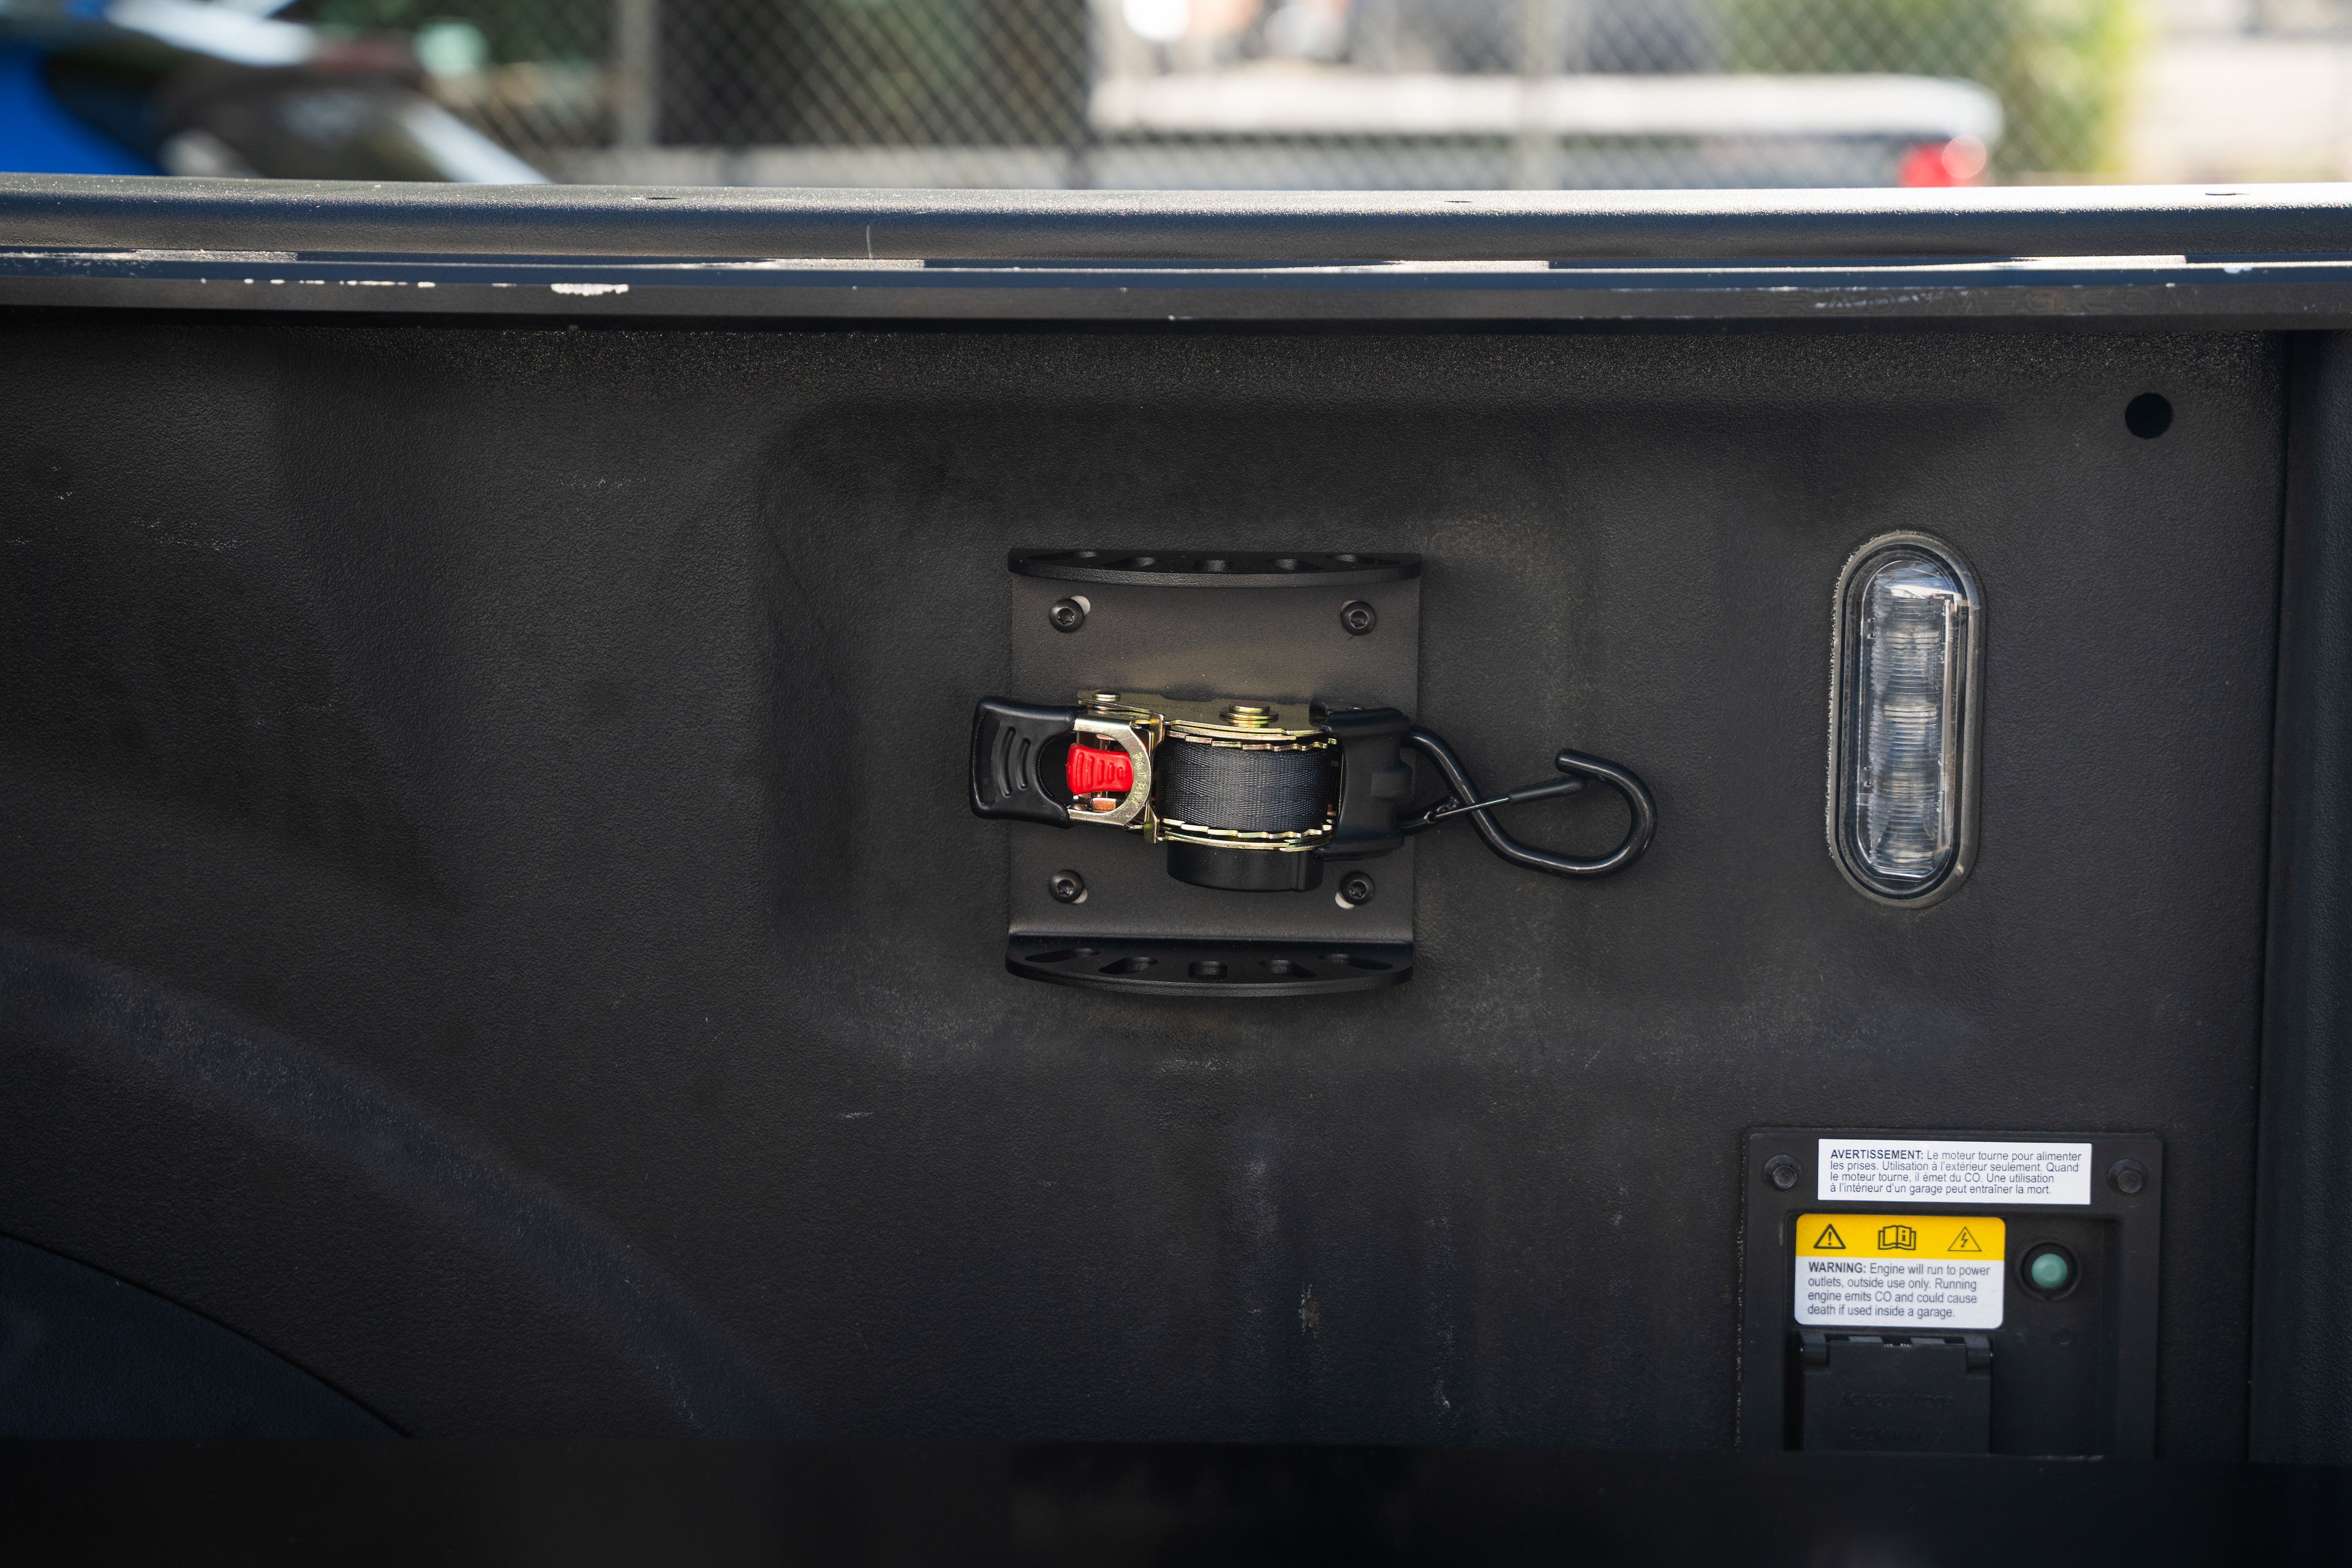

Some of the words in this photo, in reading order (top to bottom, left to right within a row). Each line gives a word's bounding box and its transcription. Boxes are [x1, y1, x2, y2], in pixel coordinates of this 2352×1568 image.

[1831, 1150, 1923, 1159] AVERTISSEMENT:
[1928, 1151, 1939, 1159] Le
[1942, 1152, 1975, 1160] moteur
[1978, 1152, 2008, 1160] tourne
[2012, 1153, 2033, 1163] pour
[2037, 1152, 2081, 1161] alimenter
[1831, 1161, 1844, 1170] les
[1847, 1161, 1879, 1172] prises.
[1882, 1161, 1928, 1170] Utilisation
[1932, 1162, 1937, 1170] à
[1991, 1163, 2042, 1172] seulement.
[2046, 1163, 2079, 1172] Quand
[1831, 1172, 1838, 1181] le
[1842, 1172, 1875, 1182] moteur
[1879, 1173, 1911, 1183] tourne,
[1915, 1173, 1920, 1182] il
[1923, 1172, 1947, 1182] émet
[1950, 1173, 1961, 1182] du
[1964, 1173, 1983, 1182] CO.
[1986, 1174, 2006, 1182] Une
[2009, 1174, 2054, 1183] utilisation
[1830, 1183, 1836, 1192] à
[1886, 1183, 1906, 1193] d'un
[1910, 1186, 1942, 1195] garage
[1946, 1185, 1967, 1195] peut
[1970, 1185, 2012, 1194] entraîner
[2016, 1185, 2024, 1194] la
[1809, 1262, 1866, 1273] WARNING:
[1870, 1262, 1904, 1276] Engine
[1908, 1264, 1923, 1275] will
[1928, 1266, 1943, 1275] run
[1947, 1265, 1956, 1275] to
[1959, 1266, 1990, 1278] power
[1808, 1276, 1844, 1289] outlets,
[1847, 1278, 1883, 1287] outside
[1887, 1280, 1905, 1288] use
[1908, 1278, 1930, 1291] only.
[1935, 1278, 1977, 1292] Running
[1808, 1291, 1841, 1303] engine
[1844, 1291, 1872, 1302] emits
[1875, 1291, 1892, 1302] CO
[1894, 1292, 1913, 1302] and
[1917, 1292, 1943, 1303] could
[1947, 1294, 1977, 1303] cause
[1807, 1304, 1835, 1314] death
[1839, 1305, 1845, 1314] if
[1847, 1305, 1871, 1315] used
[1874, 1305, 1904, 1316] inside
[1917, 1308, 1955, 1319] garage.
